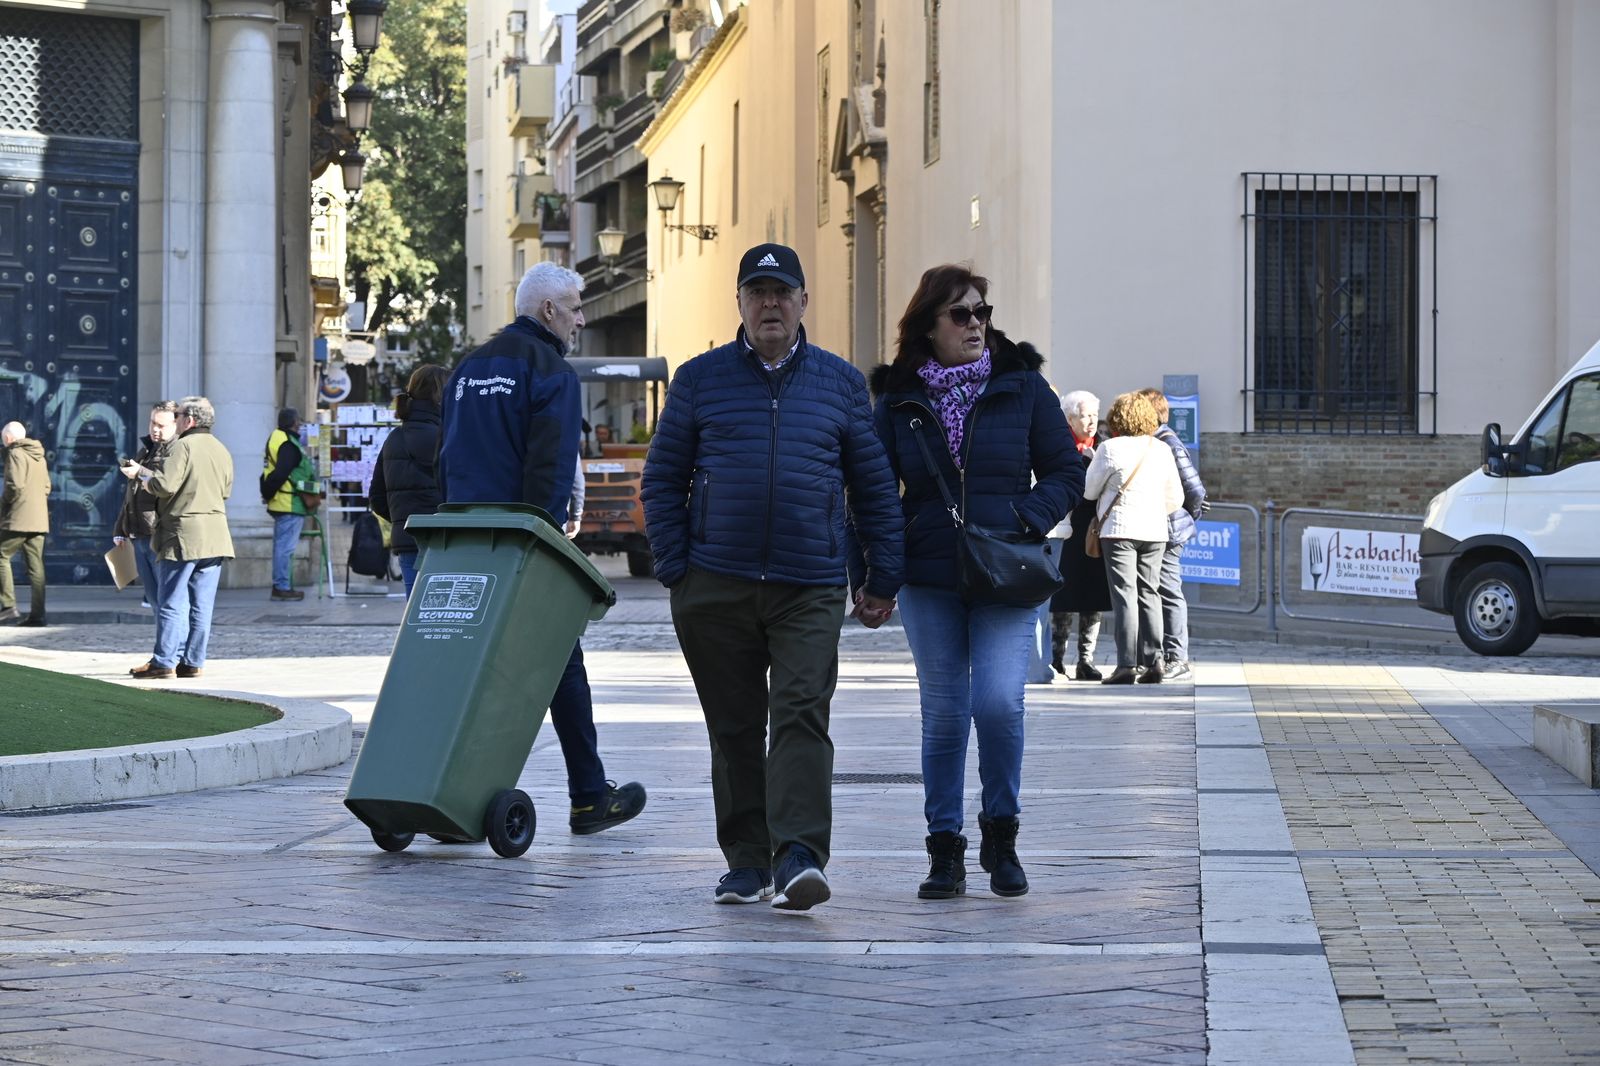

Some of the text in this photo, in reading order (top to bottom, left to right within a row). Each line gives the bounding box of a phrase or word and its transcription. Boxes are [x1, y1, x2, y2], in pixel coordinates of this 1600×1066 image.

[1336, 561, 1353, 570] BAR
[1221, 569, 1236, 579] 109
[418, 611, 474, 620] ECOVIDRIO
